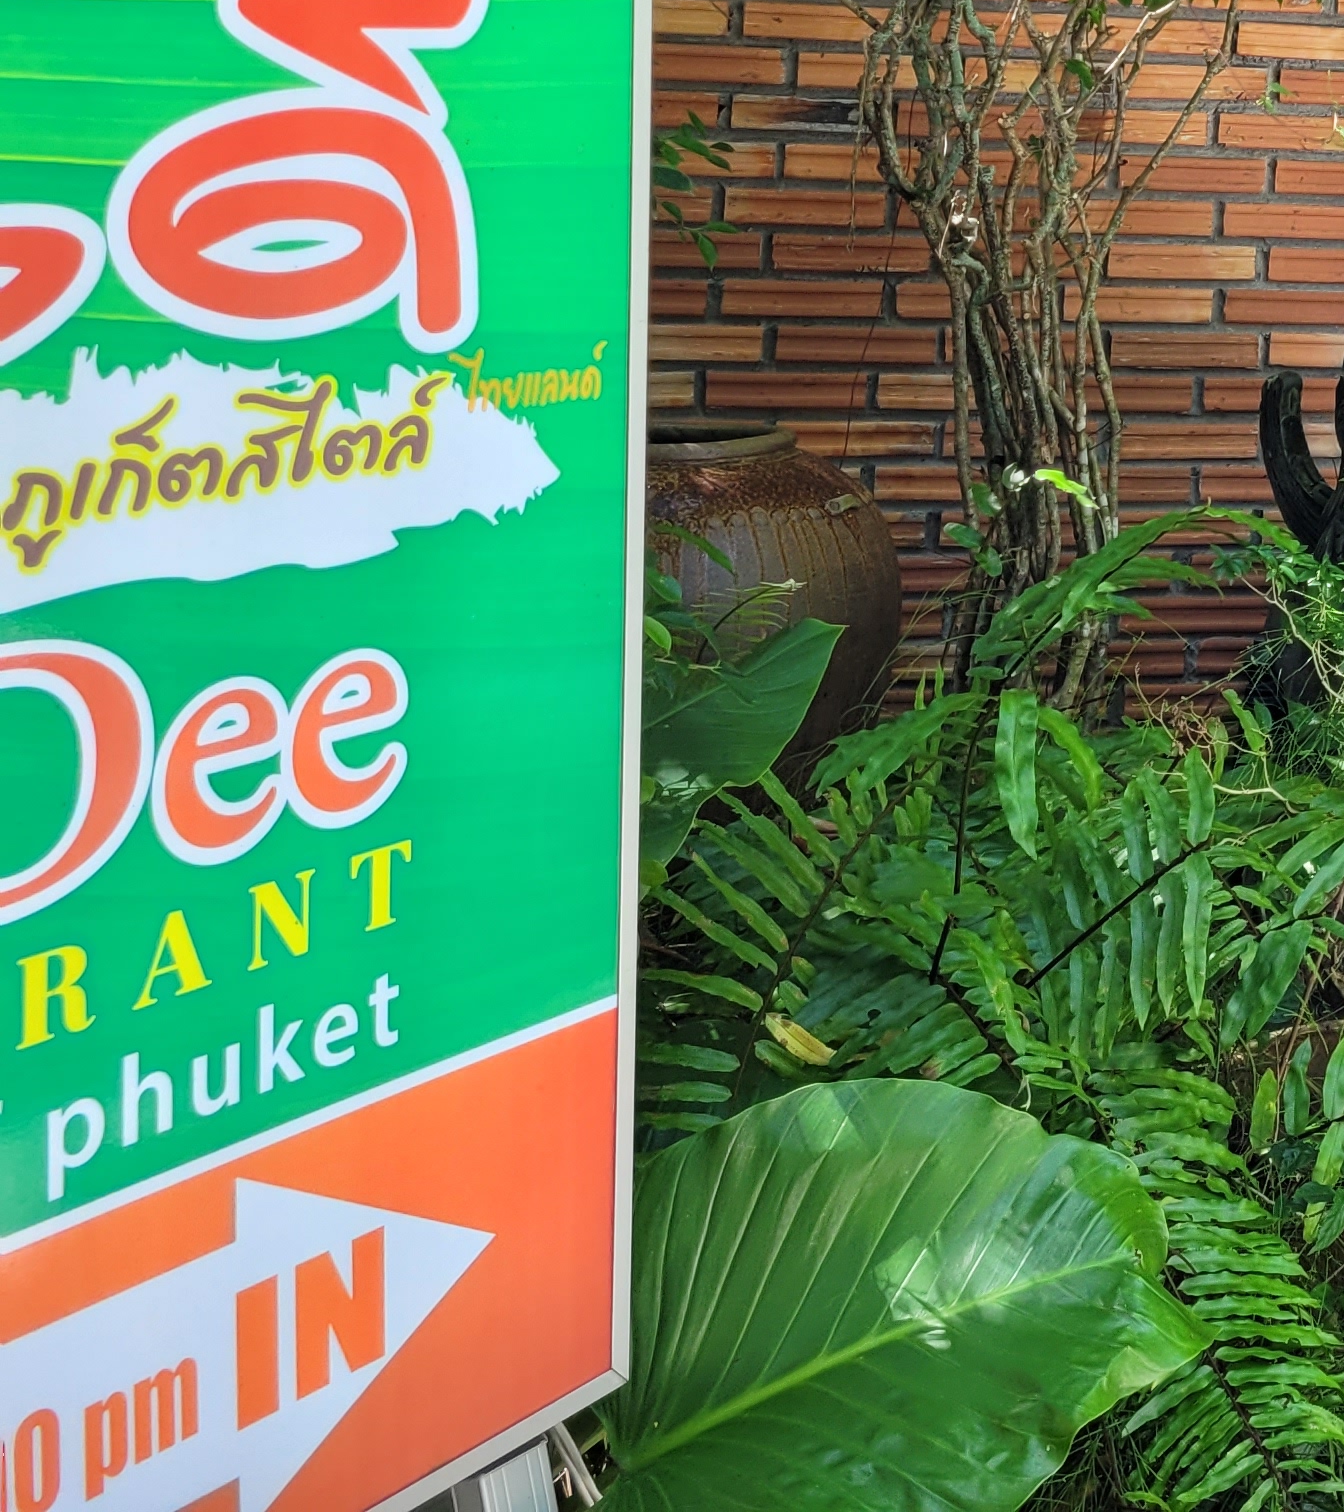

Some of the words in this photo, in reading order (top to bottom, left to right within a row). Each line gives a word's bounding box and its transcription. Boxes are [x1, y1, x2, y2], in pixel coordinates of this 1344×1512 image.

[0, 376, 452, 571] ภูเก็ตสไตล์
[448, 340, 607, 413] ไทยแลนด์
[15, 839, 412, 1051] RANT
[47, 972, 400, 1202] phuket
[0, 1407, 60, 1512] 0
[83, 1357, 198, 1502] pm
[235, 1225, 386, 1432] IN
